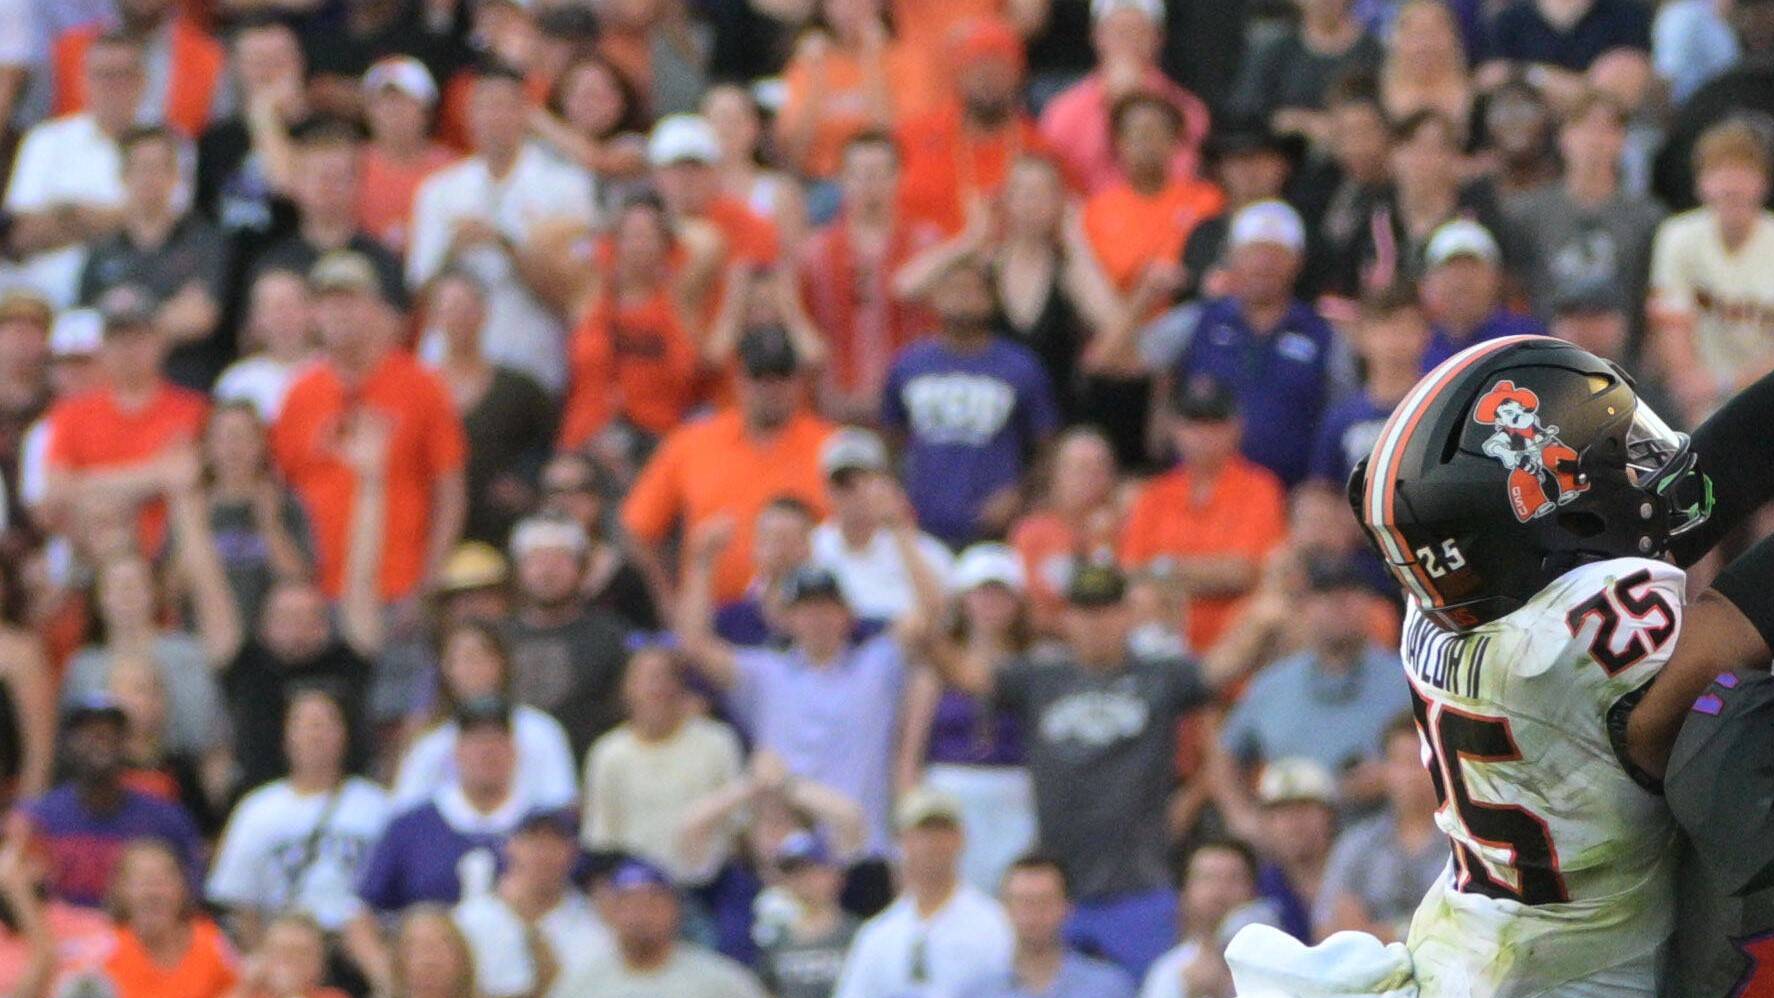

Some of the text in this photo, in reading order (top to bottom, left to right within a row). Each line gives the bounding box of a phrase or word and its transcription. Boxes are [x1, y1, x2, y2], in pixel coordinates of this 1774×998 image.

[1415, 538, 1466, 580] 25
[1565, 567, 1677, 678] 25
[1466, 635, 1491, 699] II
